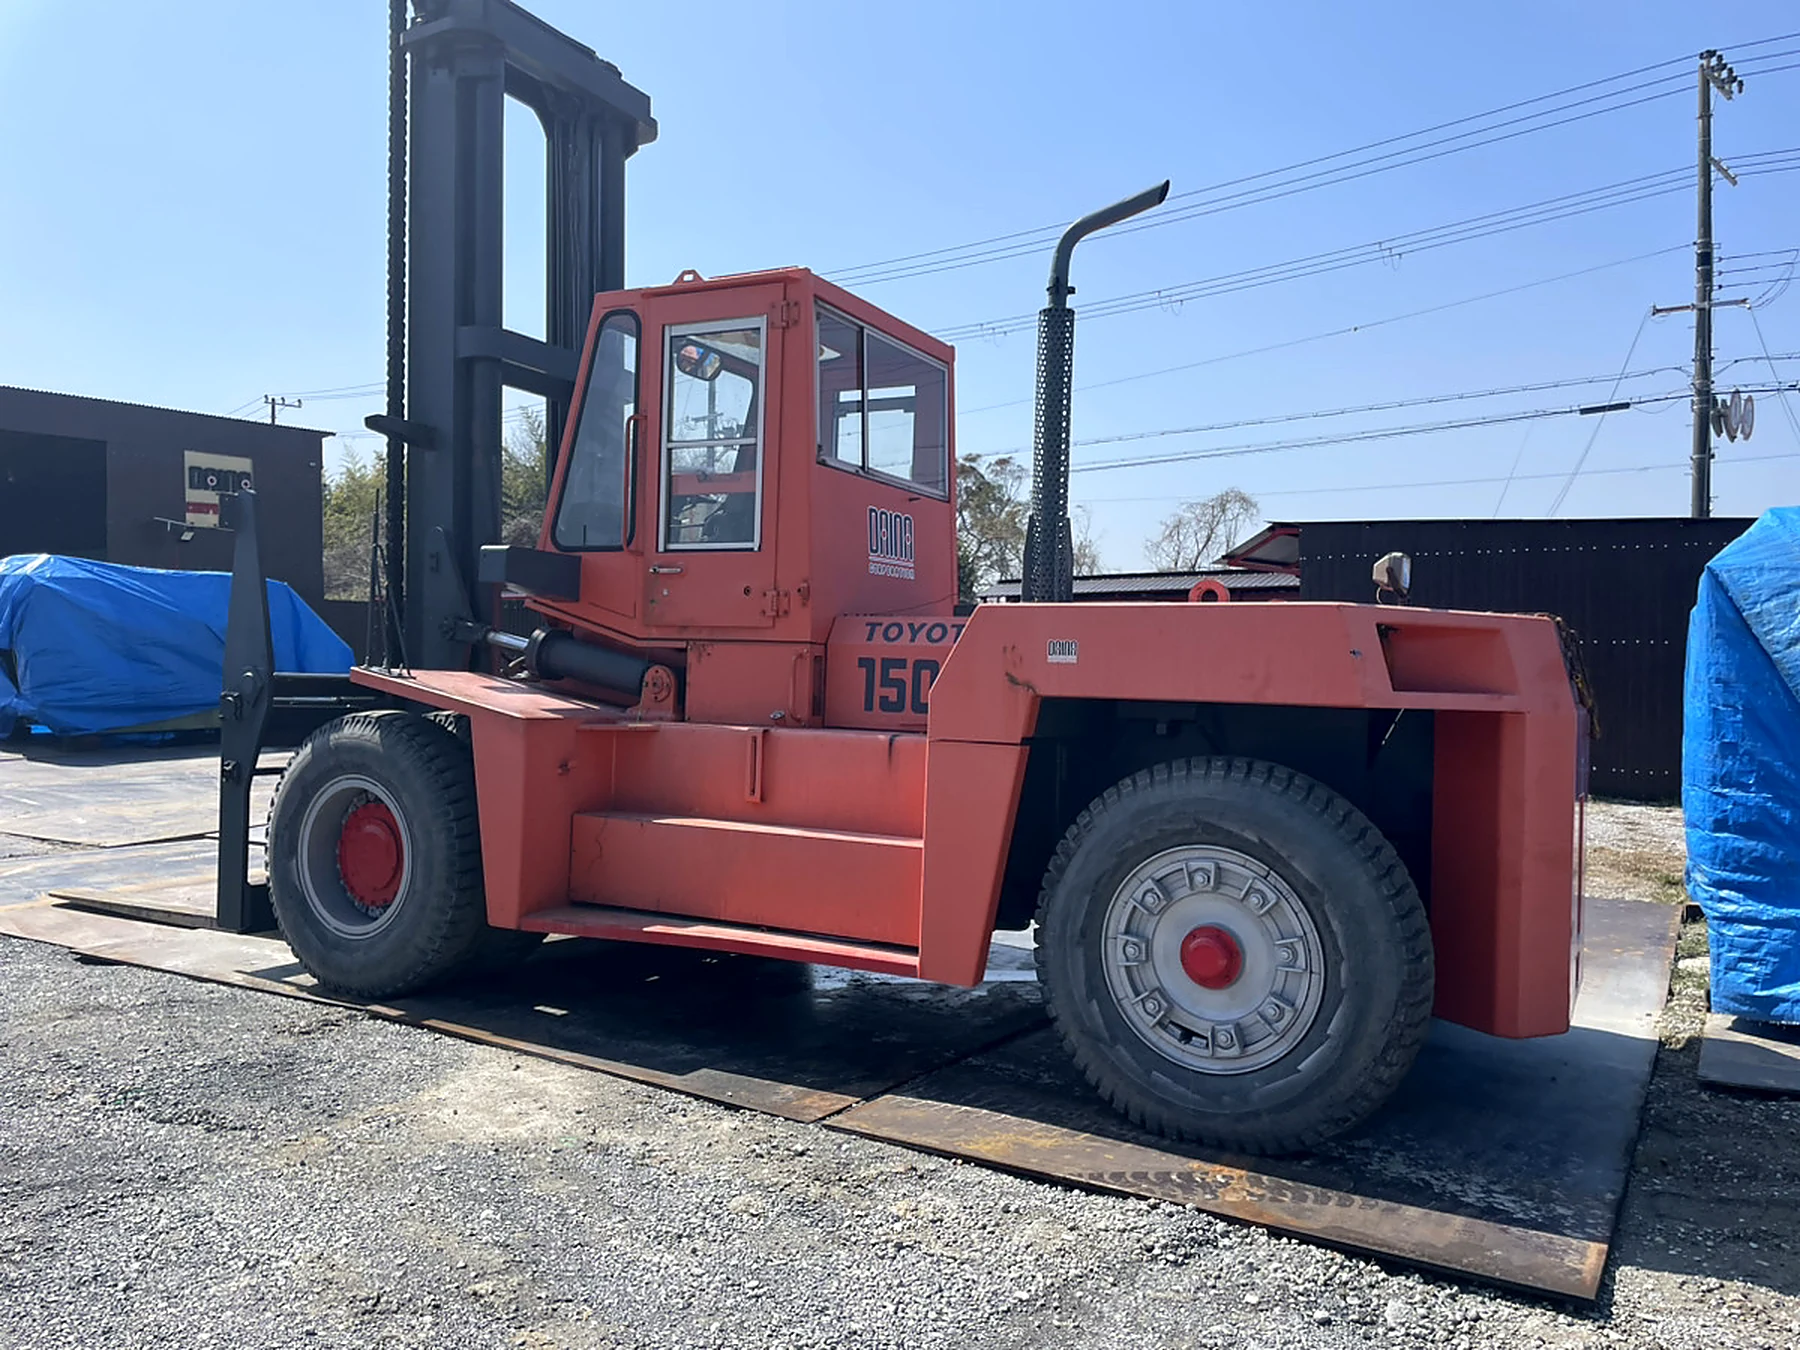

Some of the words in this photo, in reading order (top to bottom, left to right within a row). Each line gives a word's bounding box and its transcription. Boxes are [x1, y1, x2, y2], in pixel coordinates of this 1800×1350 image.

[867, 505, 915, 562] DAINA
[865, 622, 965, 643] TOYOT
[857, 656, 940, 714] 150
